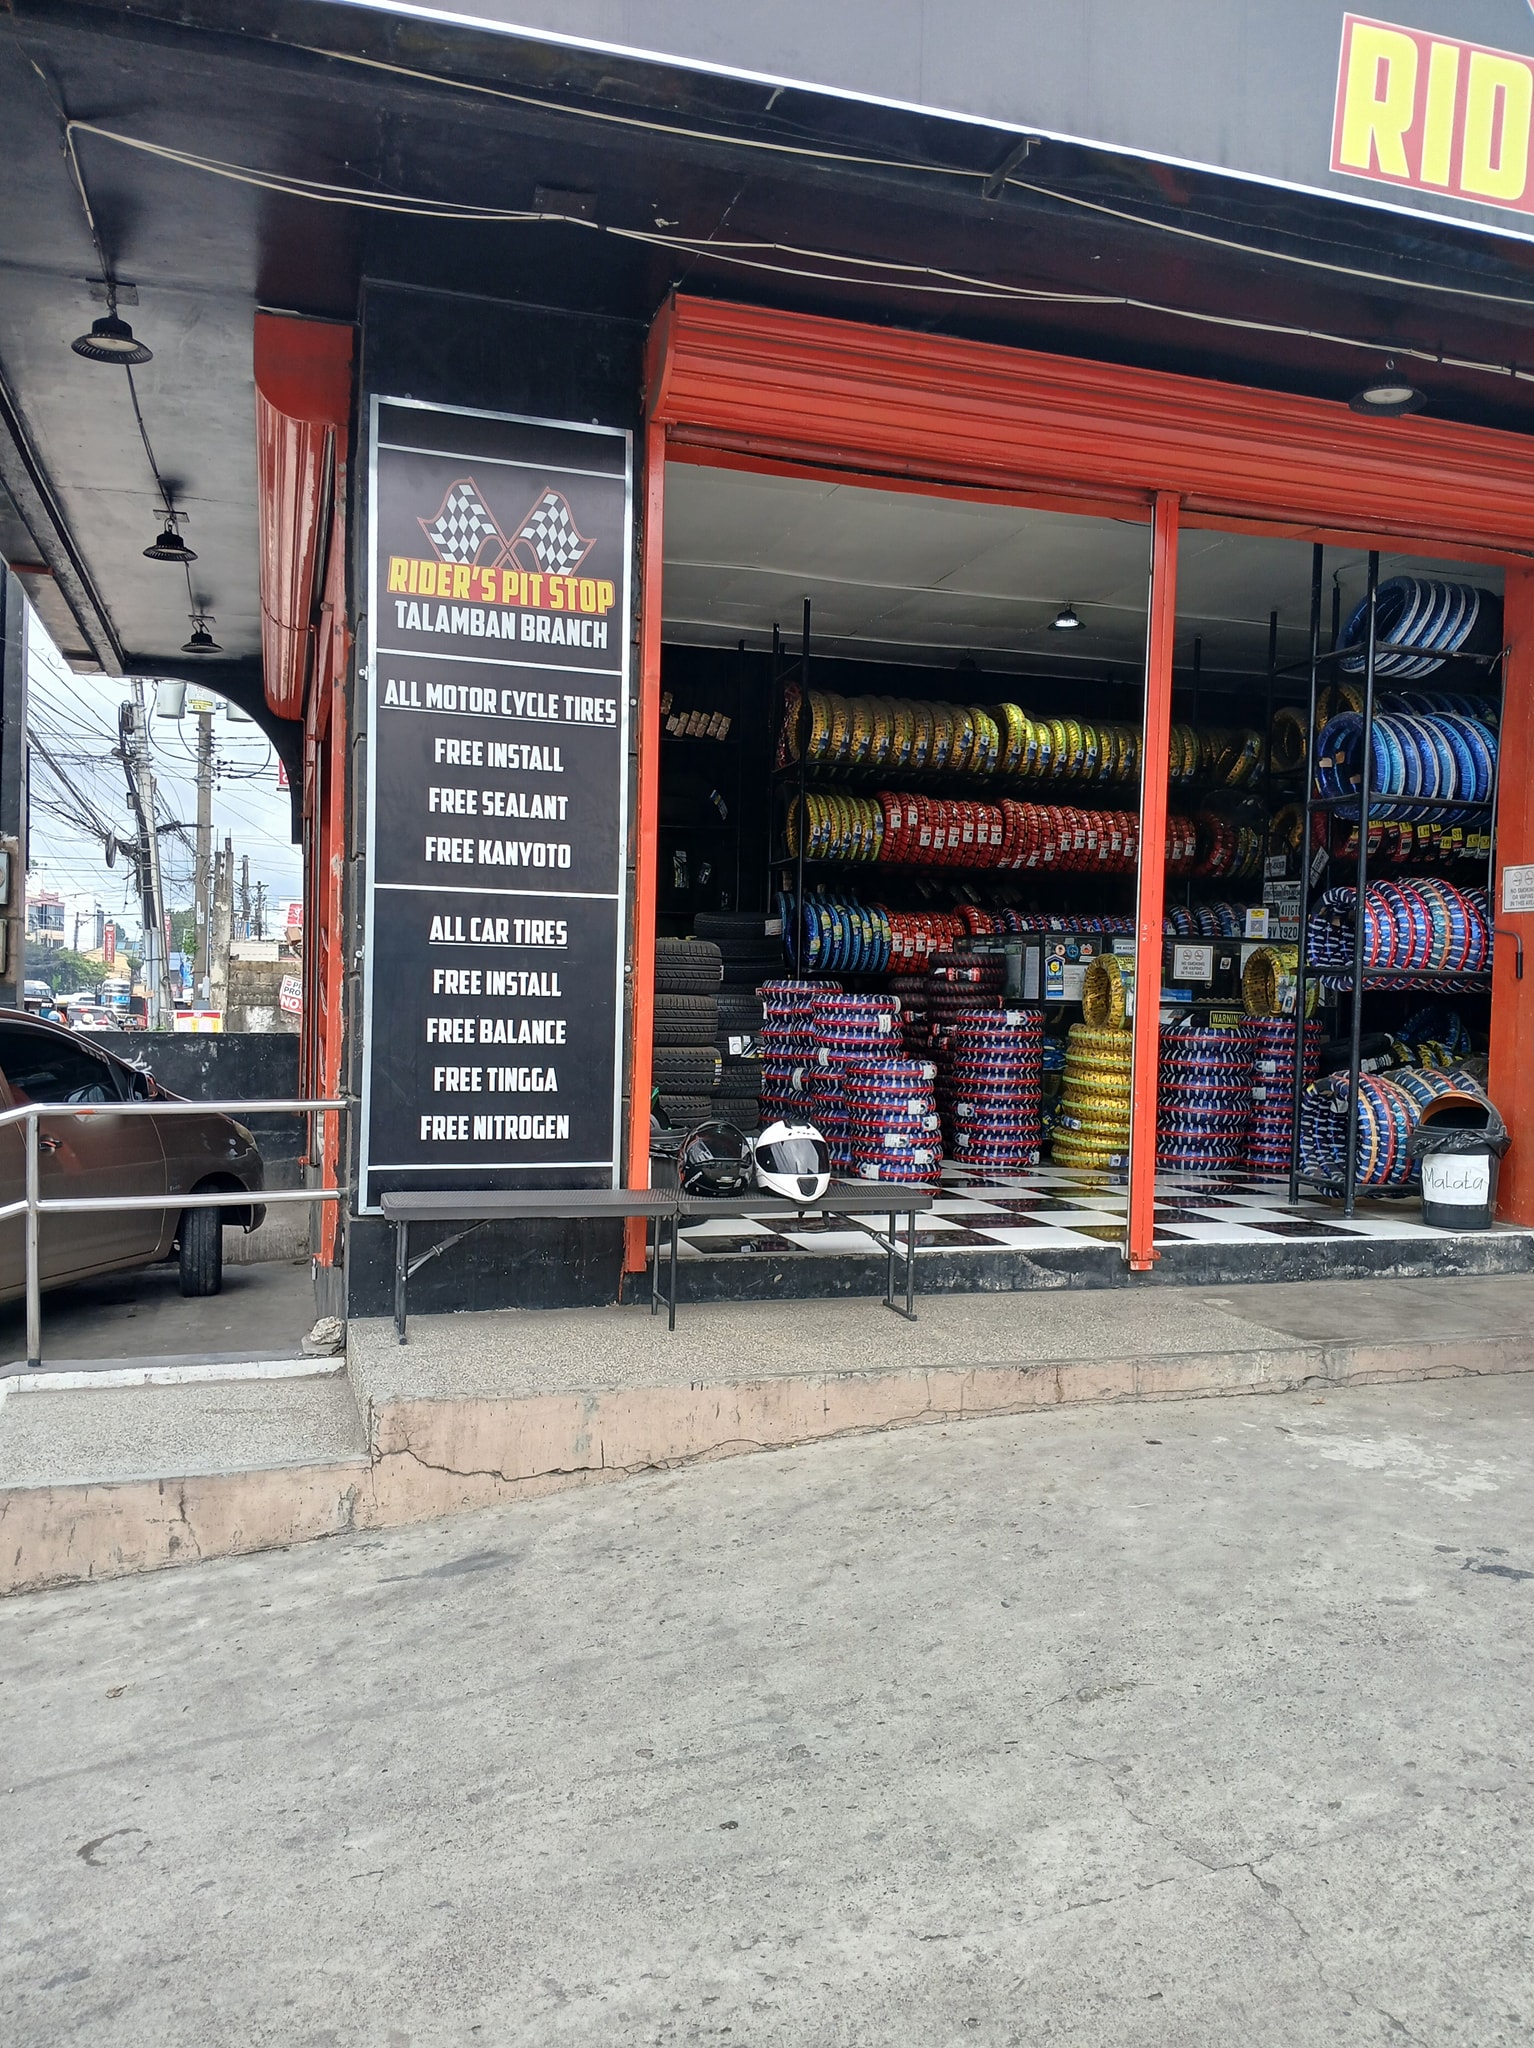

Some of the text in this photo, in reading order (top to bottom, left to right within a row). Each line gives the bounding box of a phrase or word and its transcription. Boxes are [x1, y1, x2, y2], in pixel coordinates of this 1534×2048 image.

[1339, 21, 1534, 201] RID
[388, 558, 614, 613] RIDER'S PIT STOP
[394, 600, 608, 649] TALAMBAN BRANCH
[384, 679, 617, 724] ALL MOTOR CYCLE TIRES
[434, 737, 564, 773] FREE INSTALL
[428, 786, 569, 821] FREE SEALANT
[425, 836, 571, 869] FREE KANYOTO
[429, 915, 568, 945] ALL CAR TIRES
[433, 969, 562, 997] FREE INSTALL
[426, 1018, 567, 1044] FREE BALANCE
[434, 1067, 558, 1092] FREE TINGGA
[420, 1115, 570, 1141] FREE NITROGEN
